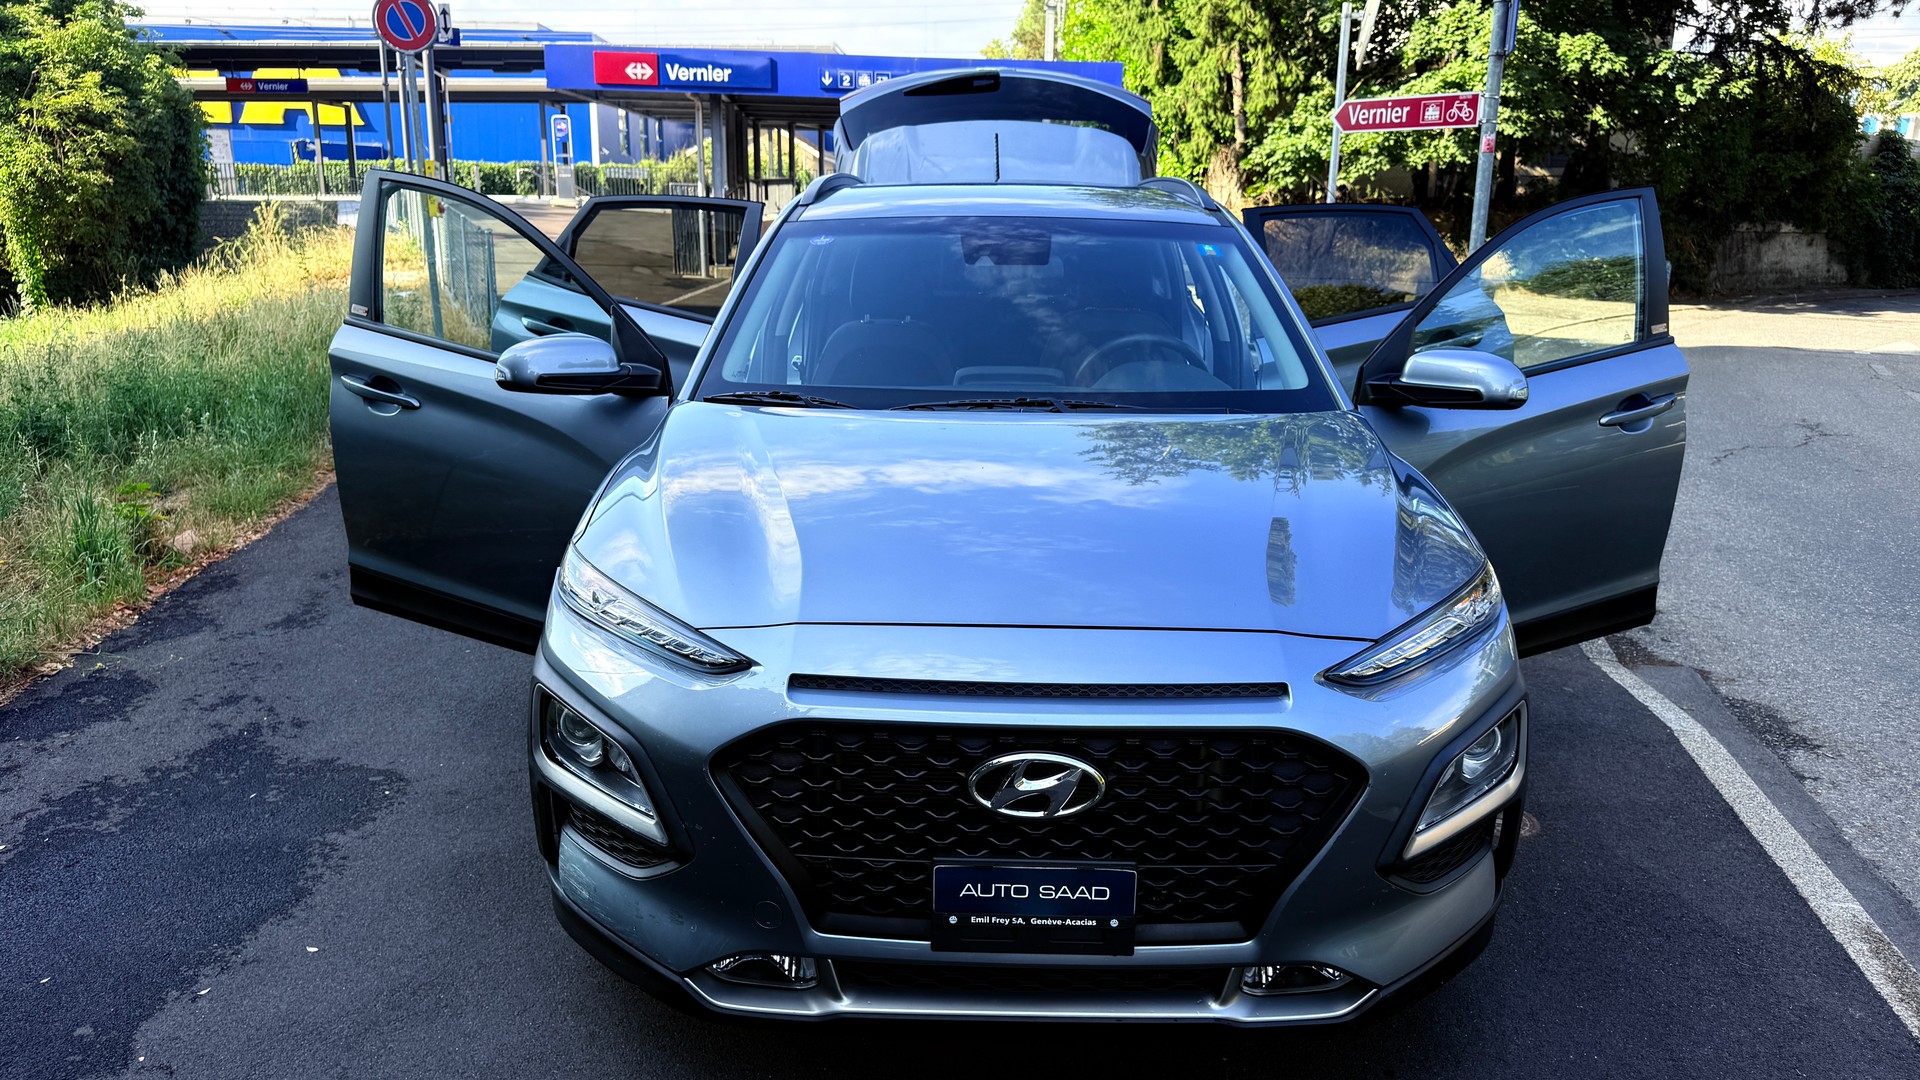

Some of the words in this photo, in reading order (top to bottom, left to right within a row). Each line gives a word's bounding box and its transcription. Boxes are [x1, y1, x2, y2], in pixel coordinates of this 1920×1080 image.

[665, 63, 732, 83] Vernier
[257, 82, 289, 91] Vernier
[1348, 101, 1411, 126] Vernier
[959, 883, 1030, 898] AUTO
[1039, 885, 1110, 901] SAAD
[970, 916, 990, 924] Emil
[991, 916, 1010, 926] Frey
[1012, 917, 1026, 926] SA,
[1030, 916, 1097, 926] Genève-Acacias
